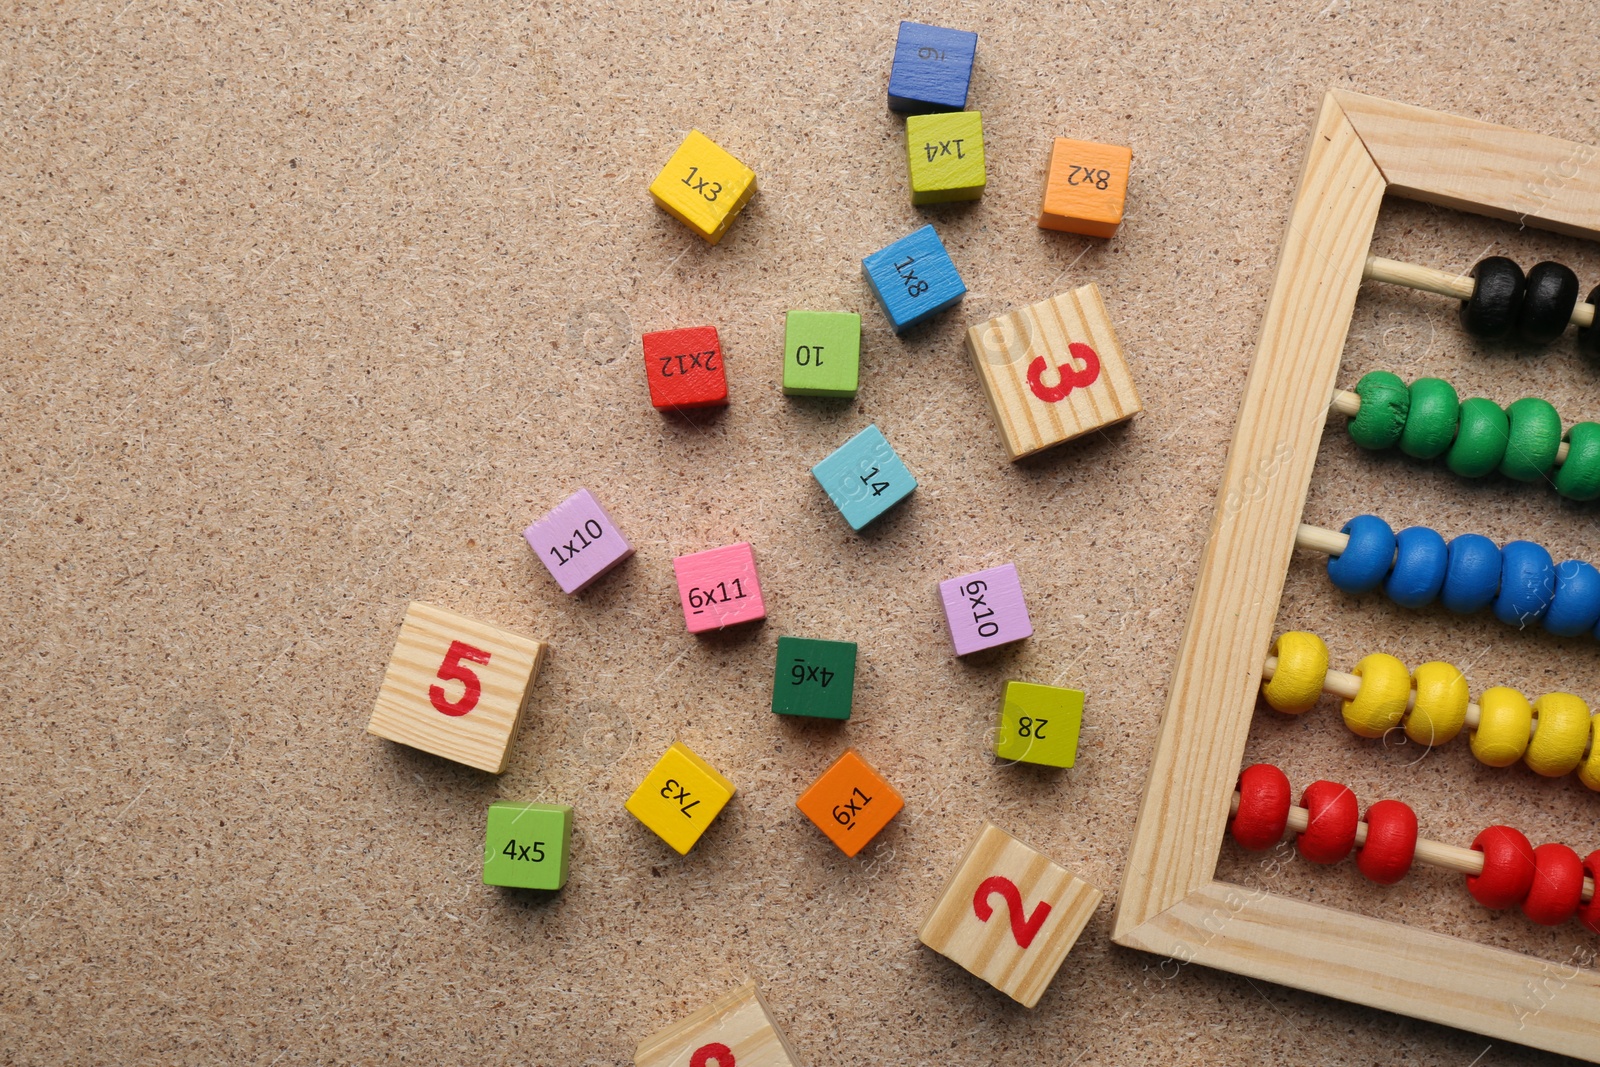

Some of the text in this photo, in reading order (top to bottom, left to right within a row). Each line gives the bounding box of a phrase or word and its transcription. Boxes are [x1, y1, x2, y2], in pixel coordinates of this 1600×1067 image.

[925, 140, 965, 162] 1x4
[682, 168, 722, 201] 1x3
[1068, 166, 1110, 190] 8x2
[895, 257, 928, 297] 1x8
[660, 351, 716, 376] 2x12
[797, 346, 824, 366] 10
[1027, 342, 1101, 403] 3
[860, 467, 889, 496] 14
[550, 519, 604, 569] 1x10
[689, 579, 746, 608] 6x11
[960, 581, 998, 637] 6x10
[428, 640, 491, 716] 5
[1019, 717, 1048, 739] 28
[661, 780, 700, 818] 7x3
[503, 840, 544, 862] 4x5
[973, 876, 1052, 949] 2
